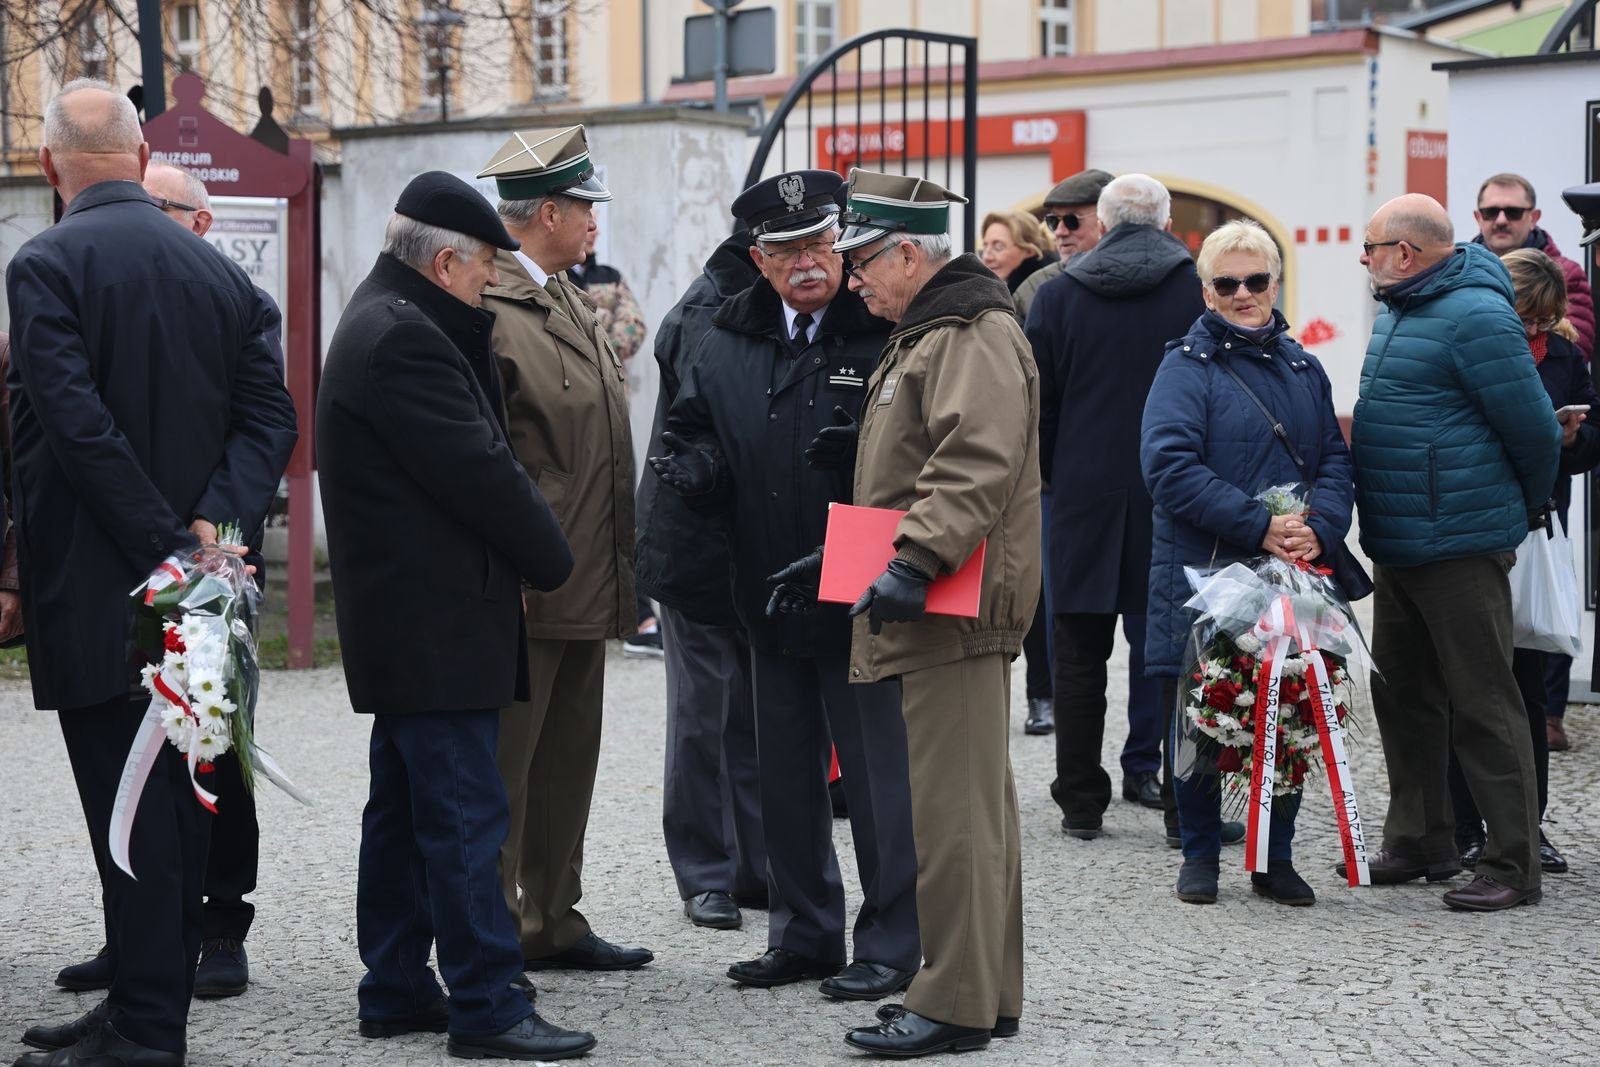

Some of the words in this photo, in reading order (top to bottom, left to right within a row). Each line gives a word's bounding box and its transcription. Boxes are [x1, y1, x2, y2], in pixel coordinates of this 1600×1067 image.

[151, 151, 212, 166] muzeum
[184, 168, 240, 182] noskie
[214, 238, 270, 263] ASY
[1308, 683, 1338, 735] IWONA
[1252, 676, 1278, 812] DOBROWOLSCY
[1327, 760, 1346, 768] I
[1336, 790, 1366, 863] ANDRZEJ
